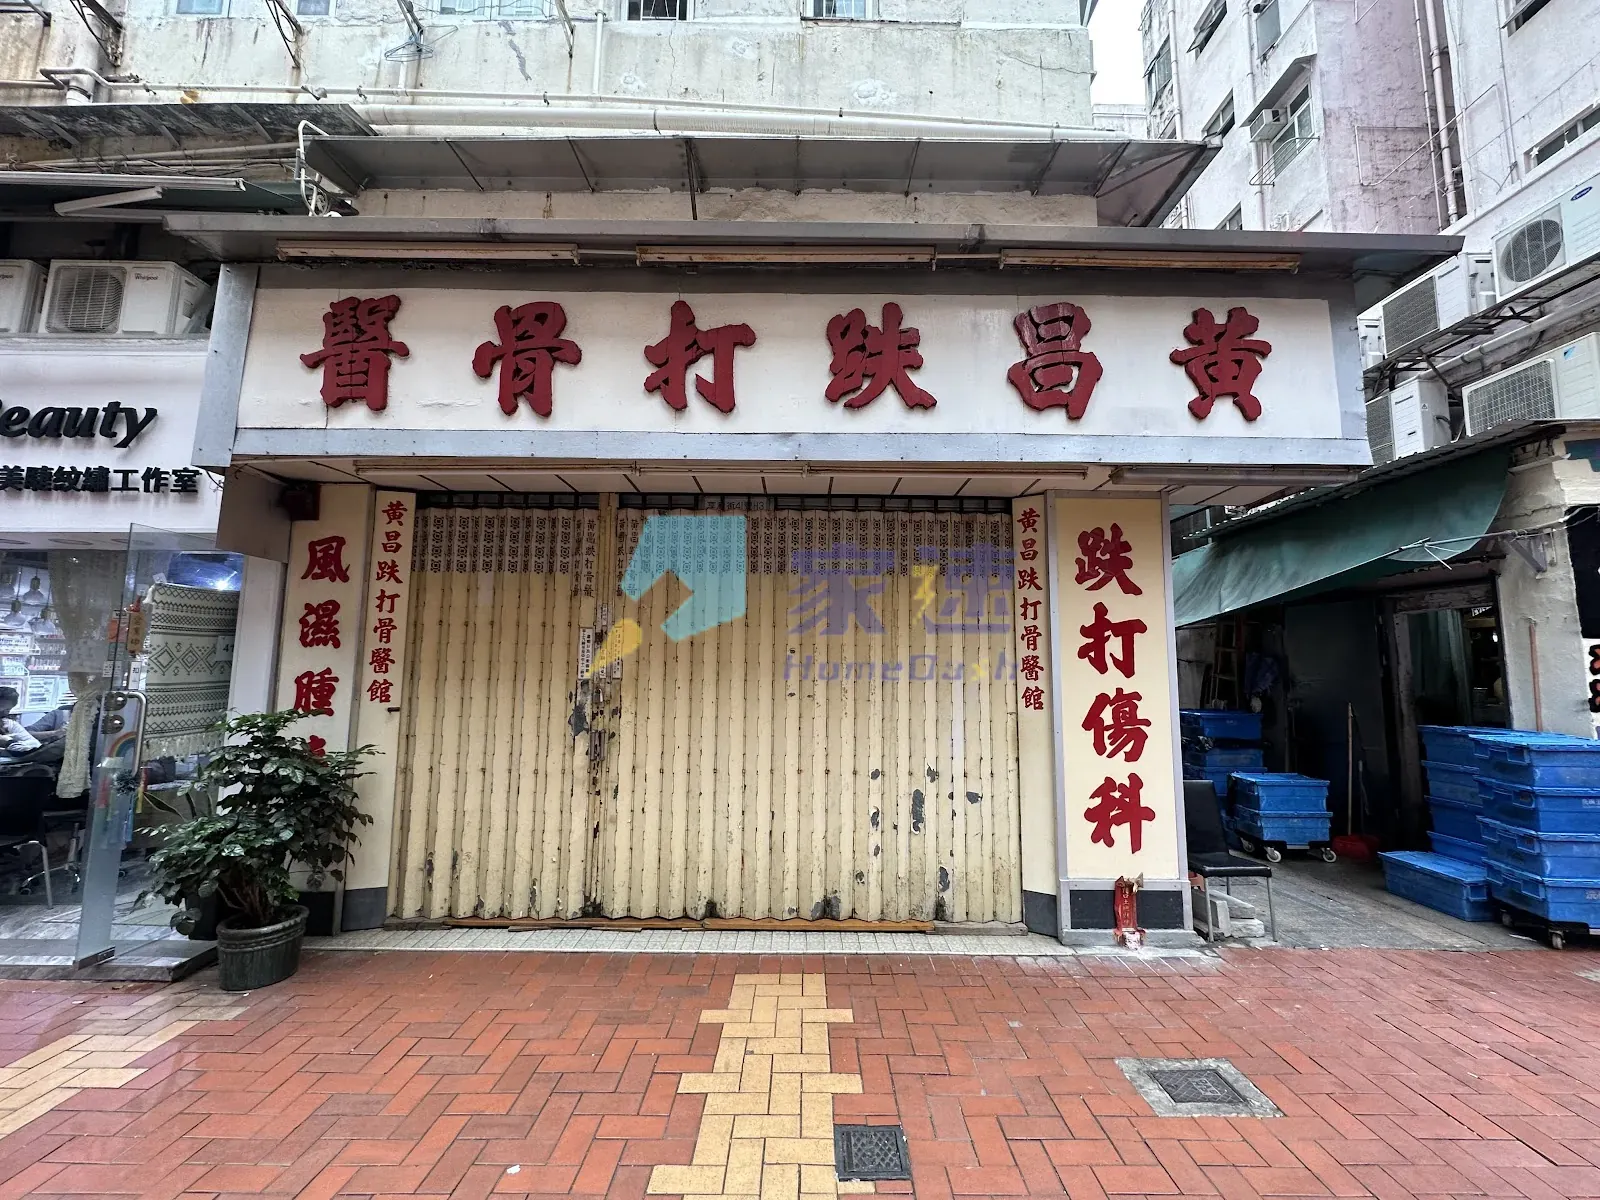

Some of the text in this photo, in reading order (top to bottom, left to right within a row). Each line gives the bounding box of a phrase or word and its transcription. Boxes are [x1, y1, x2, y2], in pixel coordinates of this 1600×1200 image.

[0, 399, 158, 448] eauty
[1074, 522, 1156, 854] 跌打傷科
